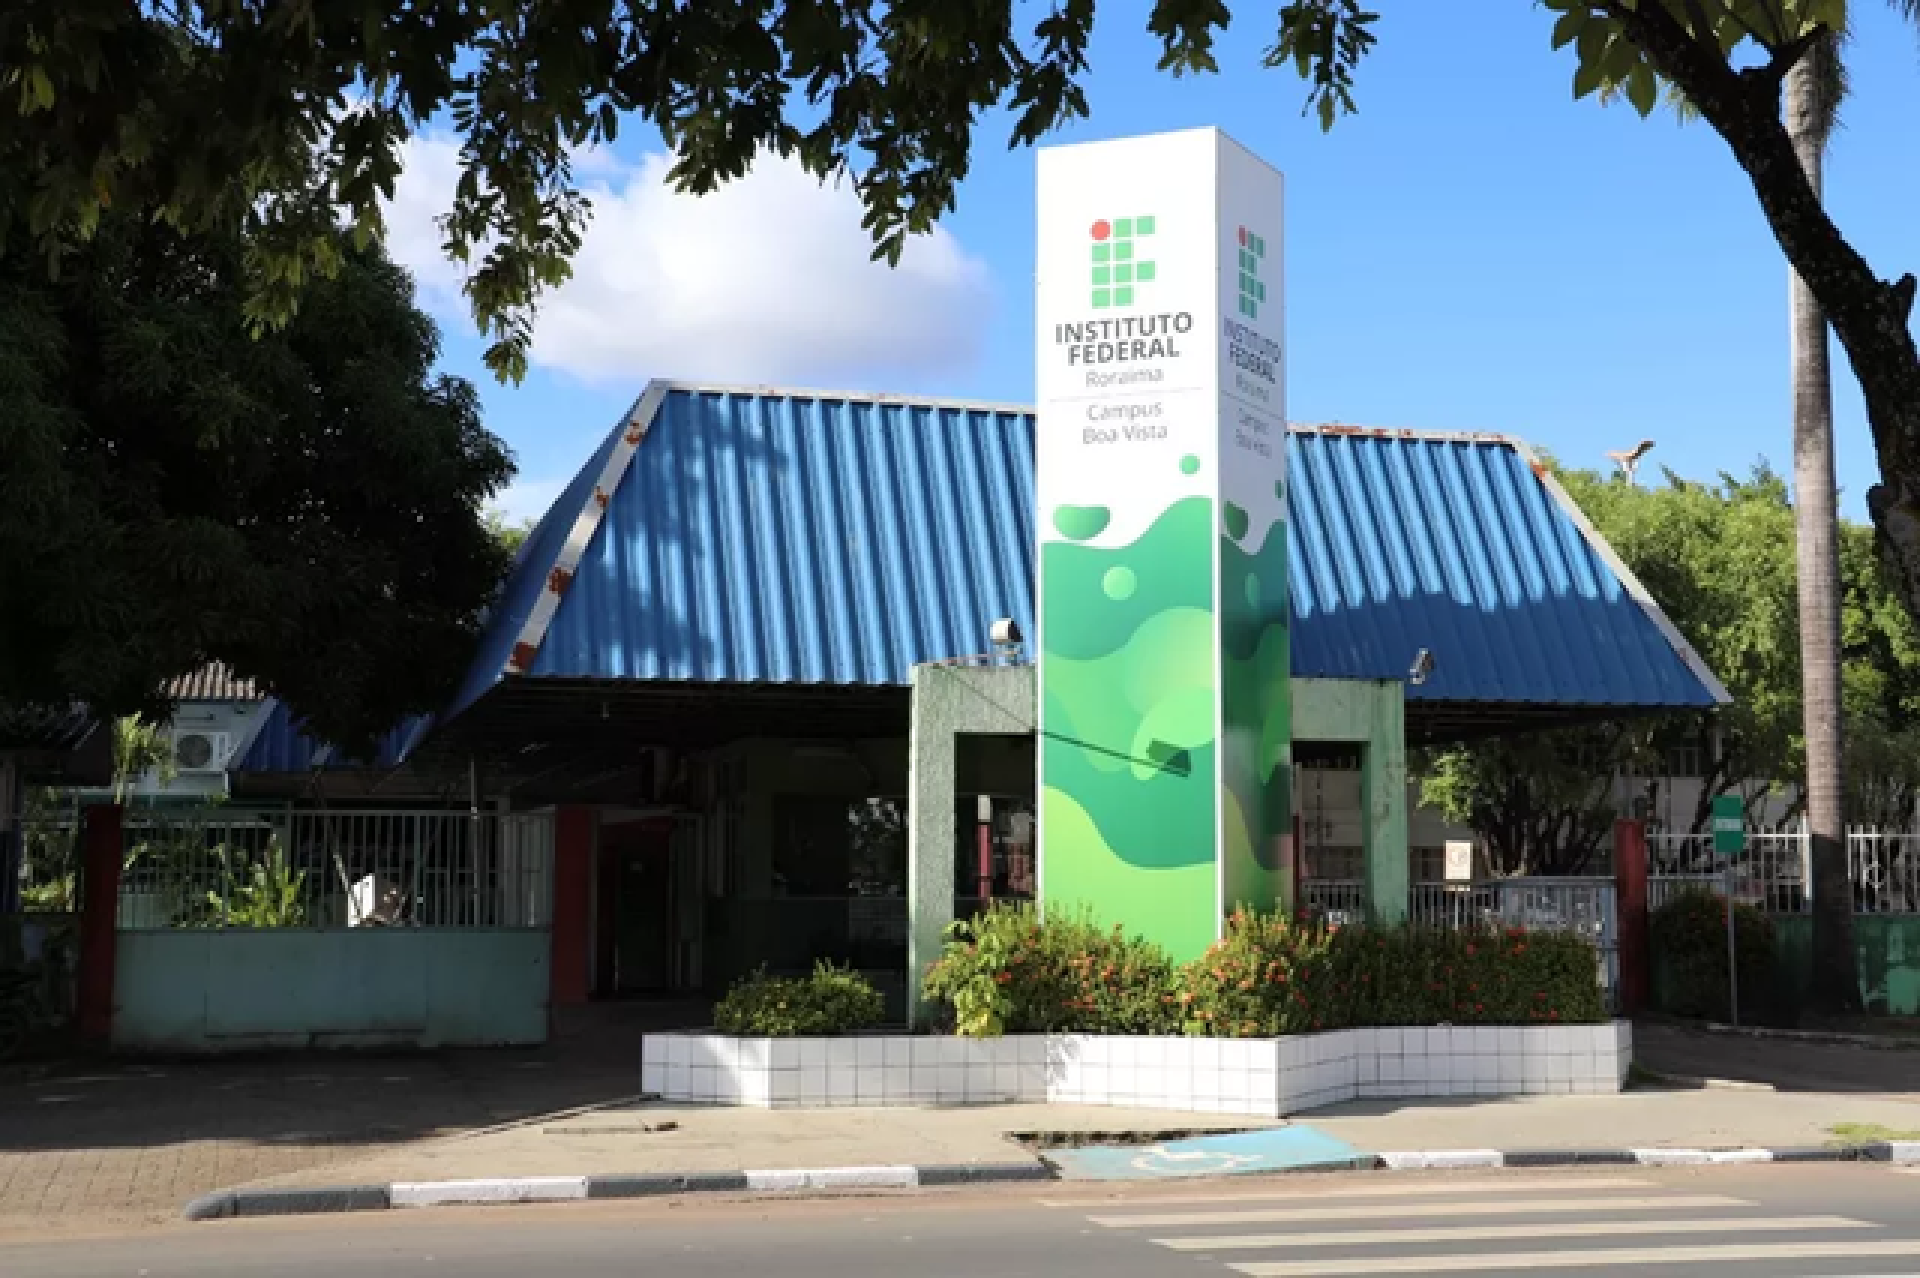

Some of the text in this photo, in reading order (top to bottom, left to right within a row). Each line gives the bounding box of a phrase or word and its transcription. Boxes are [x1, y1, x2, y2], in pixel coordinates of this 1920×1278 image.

[1055, 311, 1194, 344] INSTITUTO
[1068, 336, 1182, 366] FEDERAL
[1085, 368, 1164, 387] Roraima
[1086, 402, 1164, 422] Campus
[1082, 424, 1167, 444] Boa Vista
